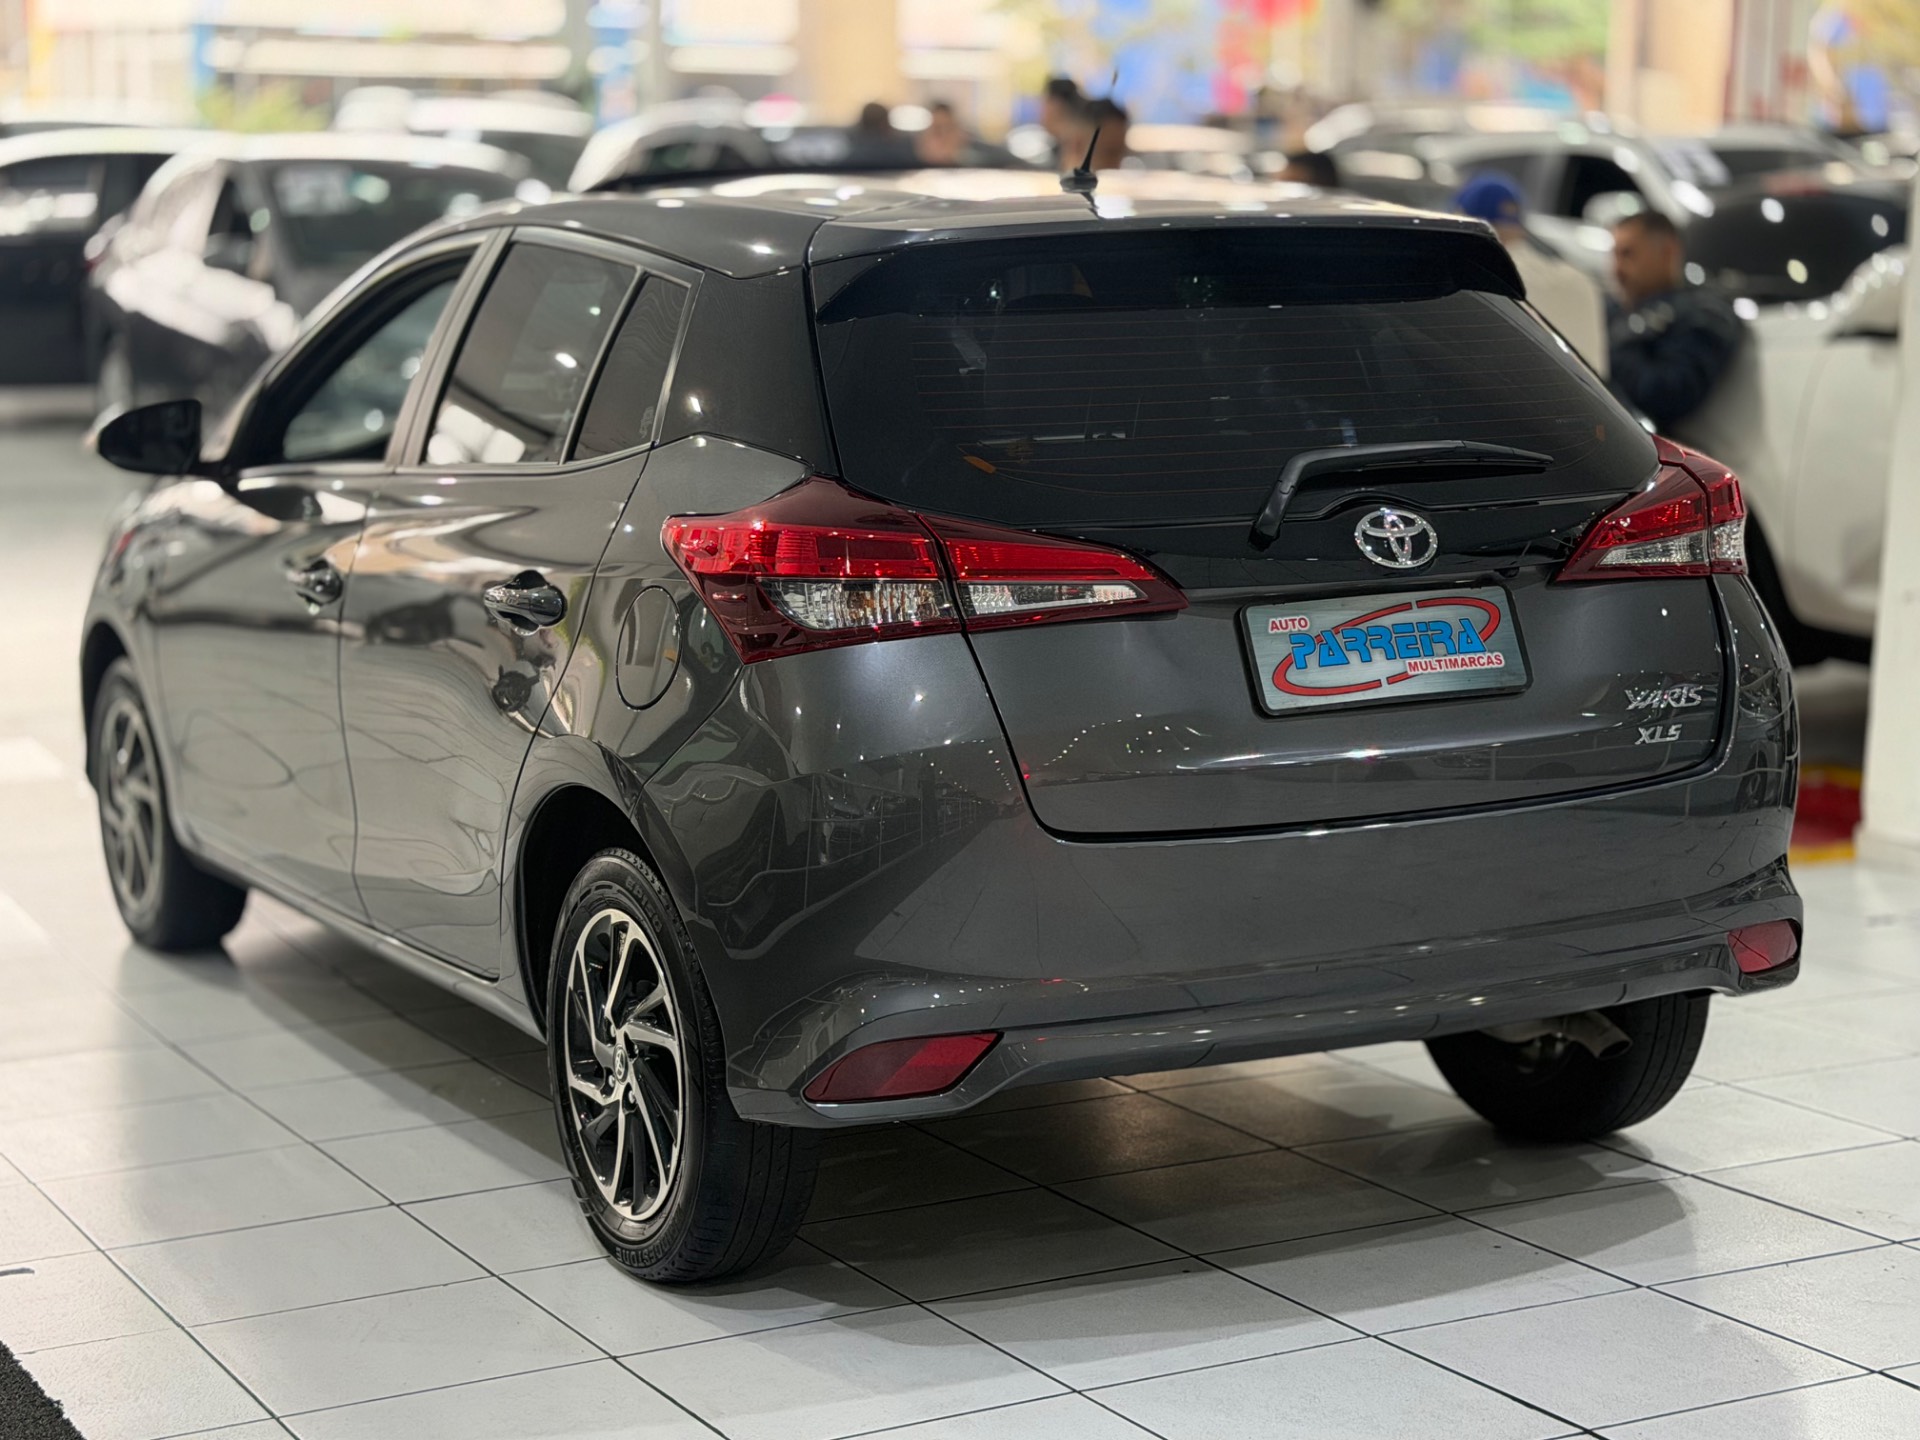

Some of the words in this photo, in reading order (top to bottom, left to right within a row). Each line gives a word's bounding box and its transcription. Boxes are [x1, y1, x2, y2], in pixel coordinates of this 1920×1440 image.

[1270, 618, 1308, 631] AUTO
[1289, 618, 1487, 669] PARREIRA
[1407, 654, 1503, 673] MULTIMARCAS
[1624, 686, 1703, 710] YARIS
[1634, 724, 1682, 745] XLS
